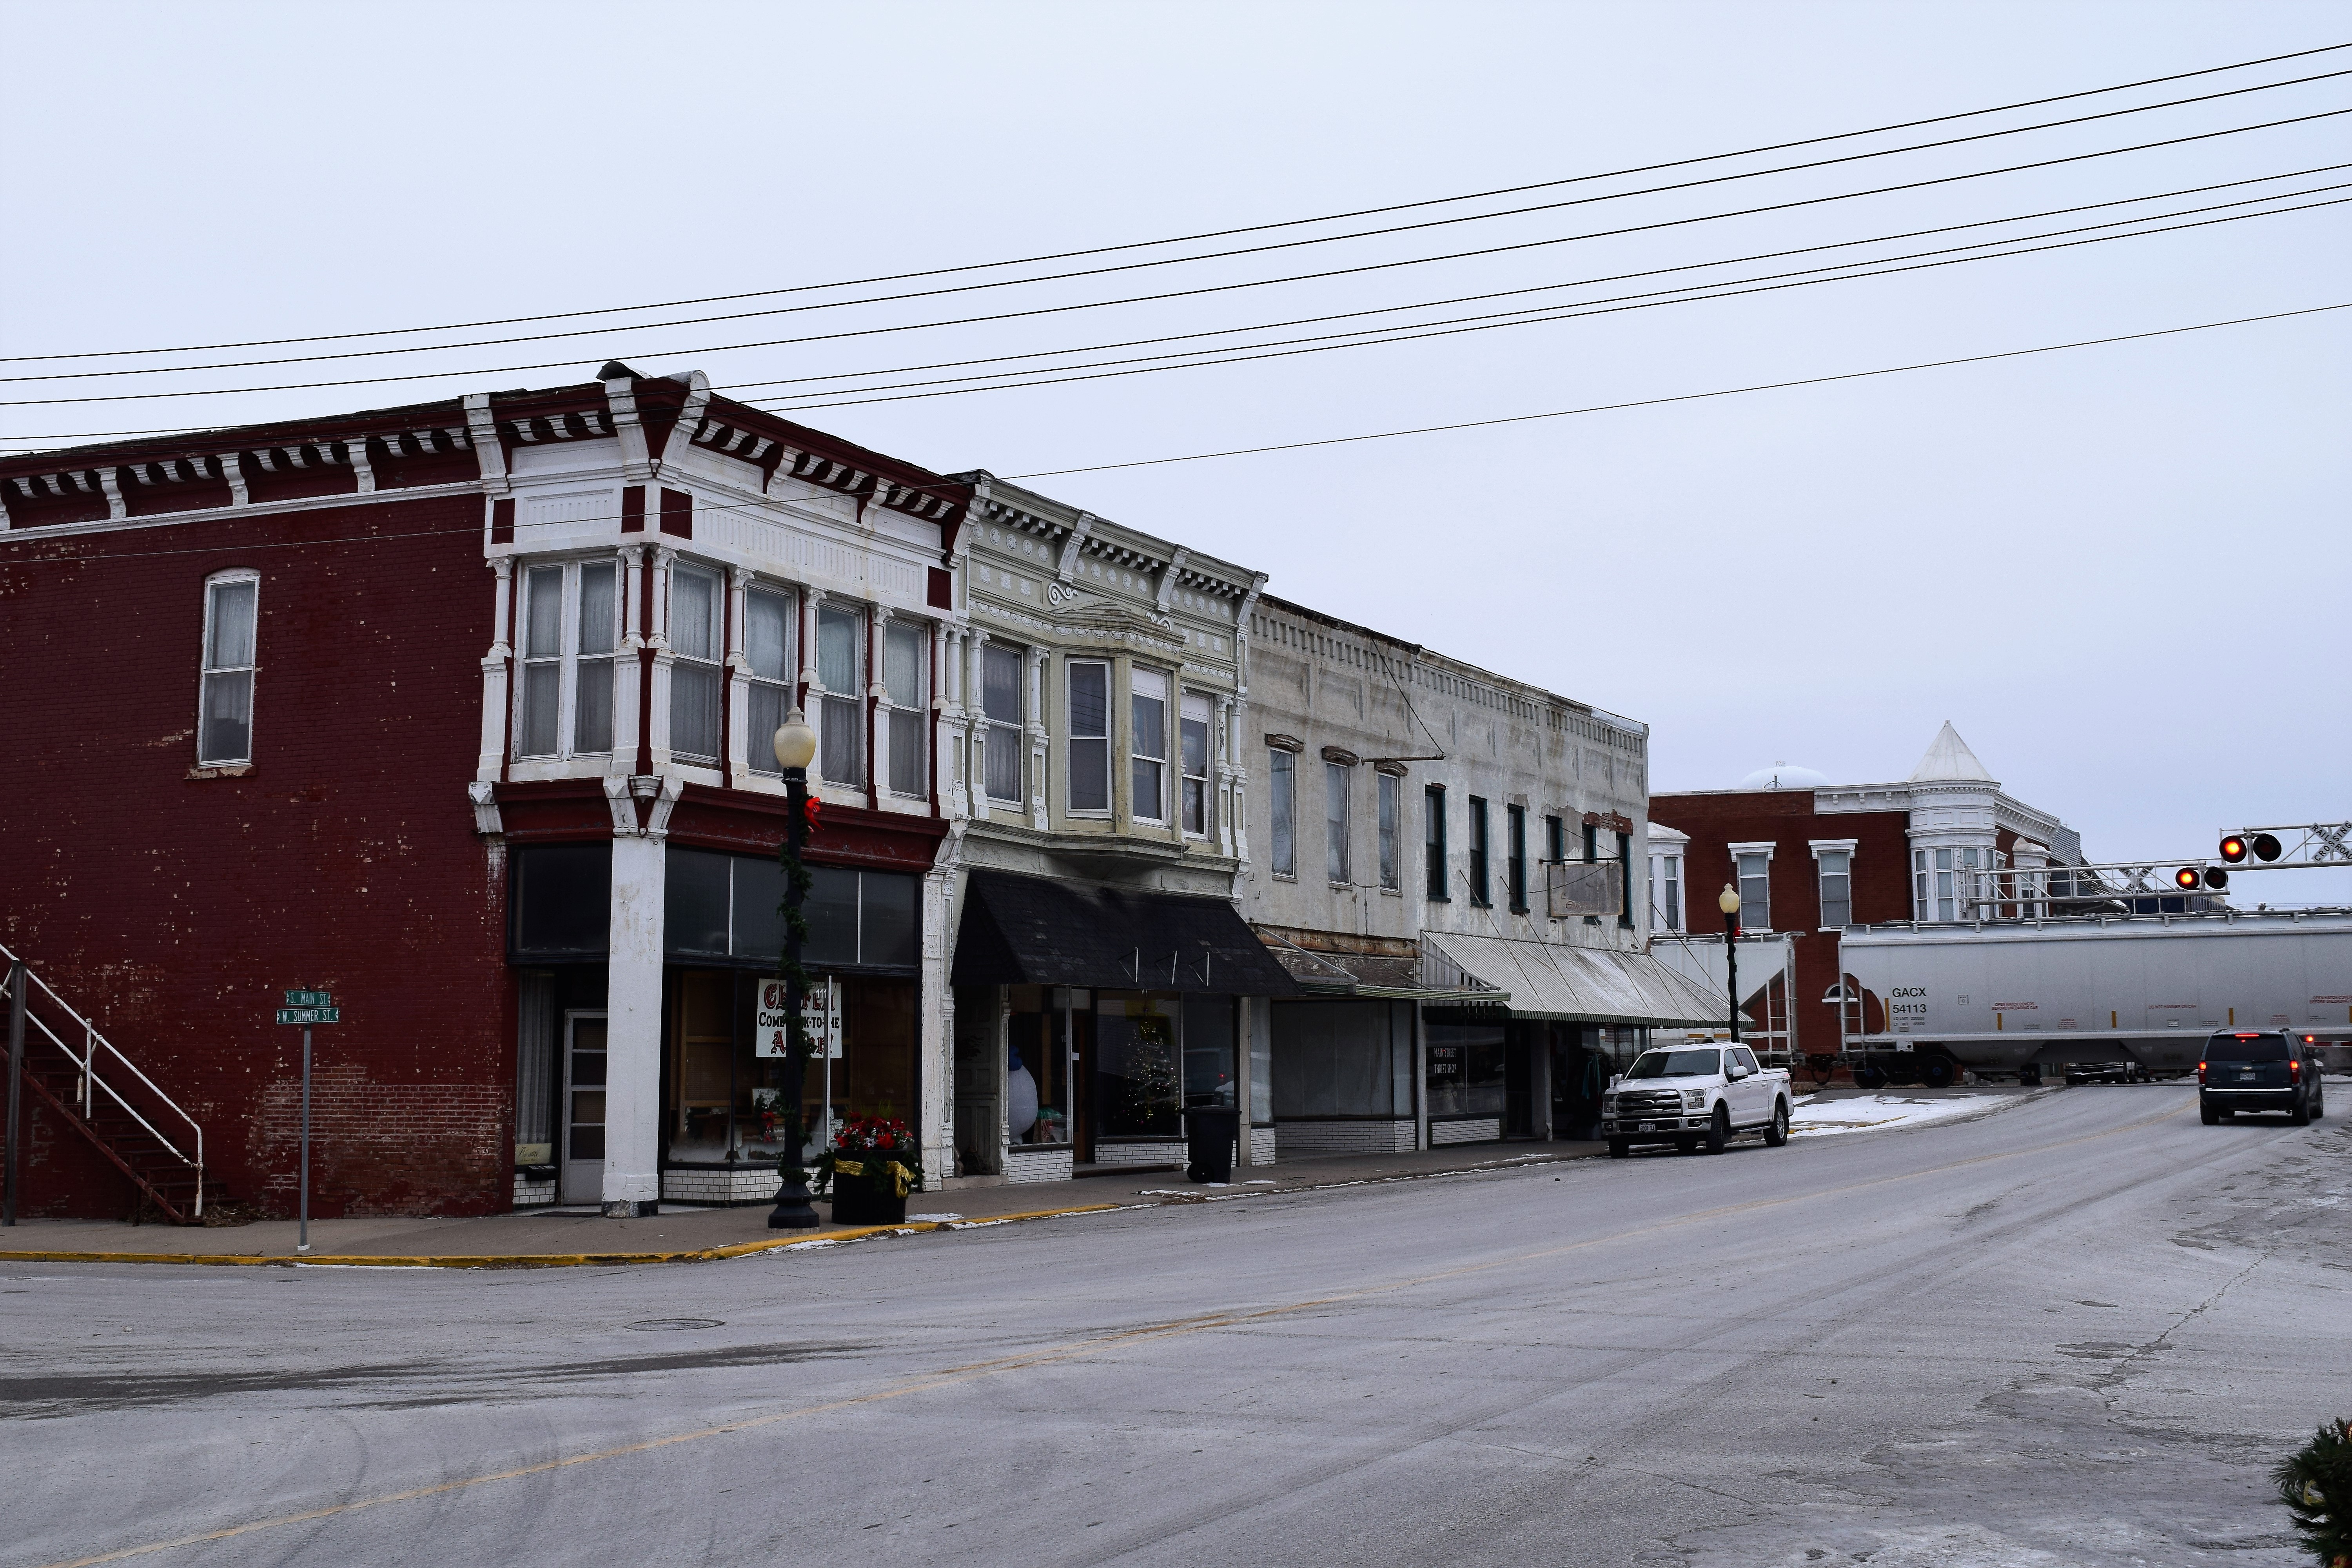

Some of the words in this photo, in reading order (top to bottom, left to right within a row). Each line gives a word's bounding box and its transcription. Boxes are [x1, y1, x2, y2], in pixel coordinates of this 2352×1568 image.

[2312, 824, 2329, 841] RAIL
[2335, 843, 2352, 860] ROAD
[2314, 822, 2352, 861] CROSSING
[816, 989, 827, 998] 111
[1892, 987, 1926, 997] GACX
[290, 992, 296, 1004] S.
[301, 993, 314, 1004] MAIN
[1893, 1004, 1926, 1013] 54113
[282, 1011, 289, 1022] W.
[294, 1010, 318, 1022] SUMMER
[323, 1009, 333, 1020] ST.
[1434, 1047, 1443, 1057] MAIN
[1445, 1048, 1456, 1058] STREET
[1434, 1064, 1446, 1074] THRIFT
[1447, 1063, 1456, 1073] SHOP
